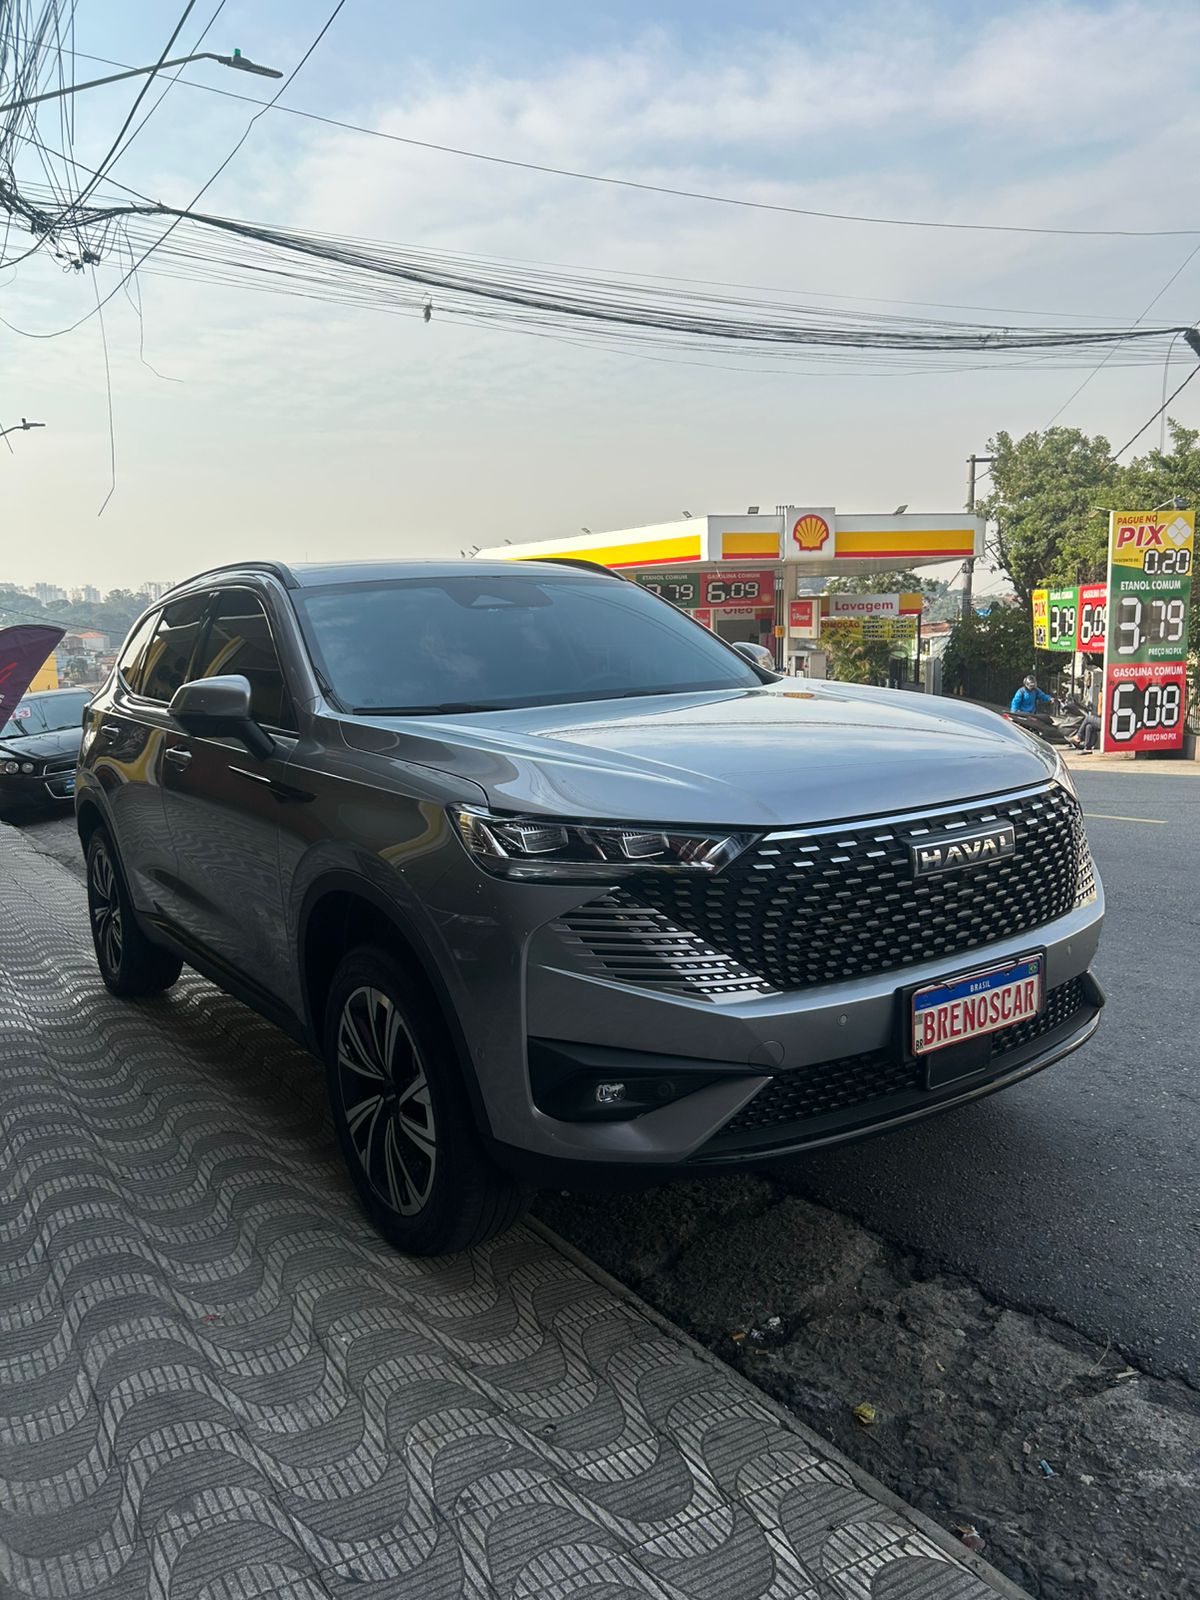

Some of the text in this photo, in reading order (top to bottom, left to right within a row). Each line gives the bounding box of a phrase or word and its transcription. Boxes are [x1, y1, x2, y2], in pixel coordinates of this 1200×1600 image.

[1117, 515, 1158, 525] PAGUE NO
[1116, 524, 1167, 549] PIX
[1144, 549, 1190, 574] 0,20
[1121, 581, 1181, 591] ETANOL COMUM
[835, 601, 893, 613] Lavagem
[1035, 602, 1046, 617] PIX
[1118, 597, 1184, 654] 3,79
[1148, 647, 1164, 657] PREÇO
[1165, 647, 1173, 655] NO
[1113, 666, 1183, 678] GASOLINA COMUM
[1111, 683, 1180, 740] 6,08
[1143, 733, 1159, 742] PREÇO
[920, 836, 1014, 870] HAVAL
[970, 980, 991, 992] BRASIL
[923, 979, 1035, 1046] BRENOSCAR
[916, 1039, 924, 1050] BR
